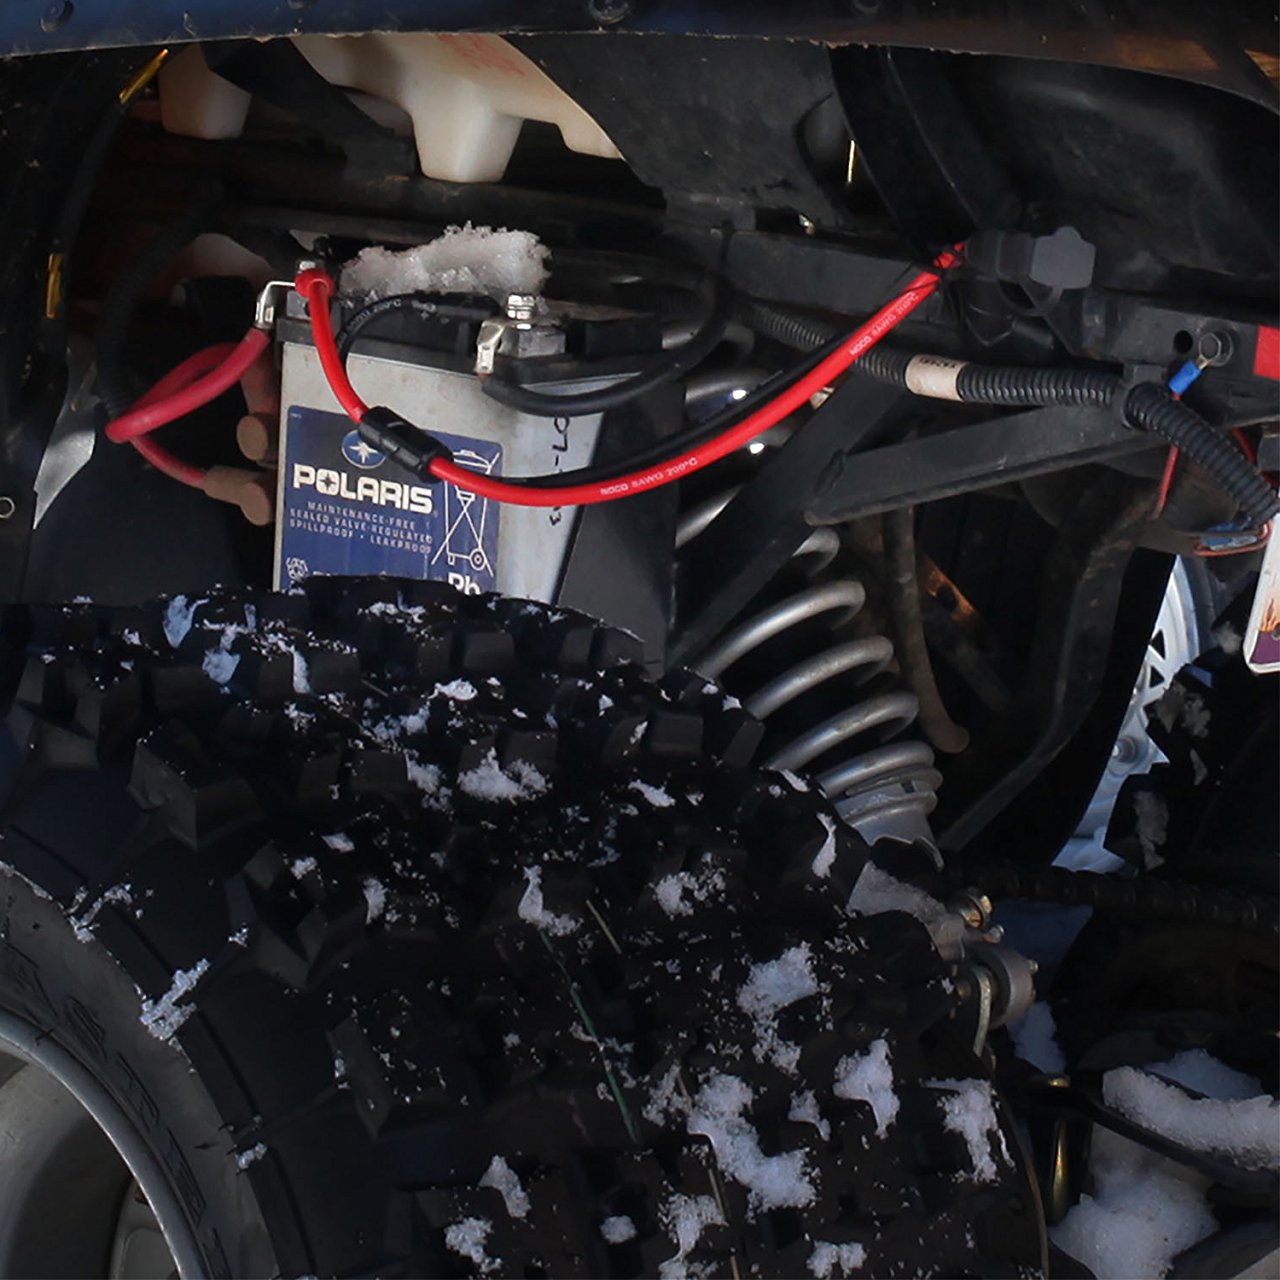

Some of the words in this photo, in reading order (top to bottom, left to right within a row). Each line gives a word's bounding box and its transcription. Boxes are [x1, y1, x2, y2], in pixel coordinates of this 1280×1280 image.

[292, 462, 433, 515] POLARIS
[289, 508, 330, 523] SEALED
[289, 519, 354, 539] SPILLPROOF
[369, 534, 433, 555] LEAKPROOF
